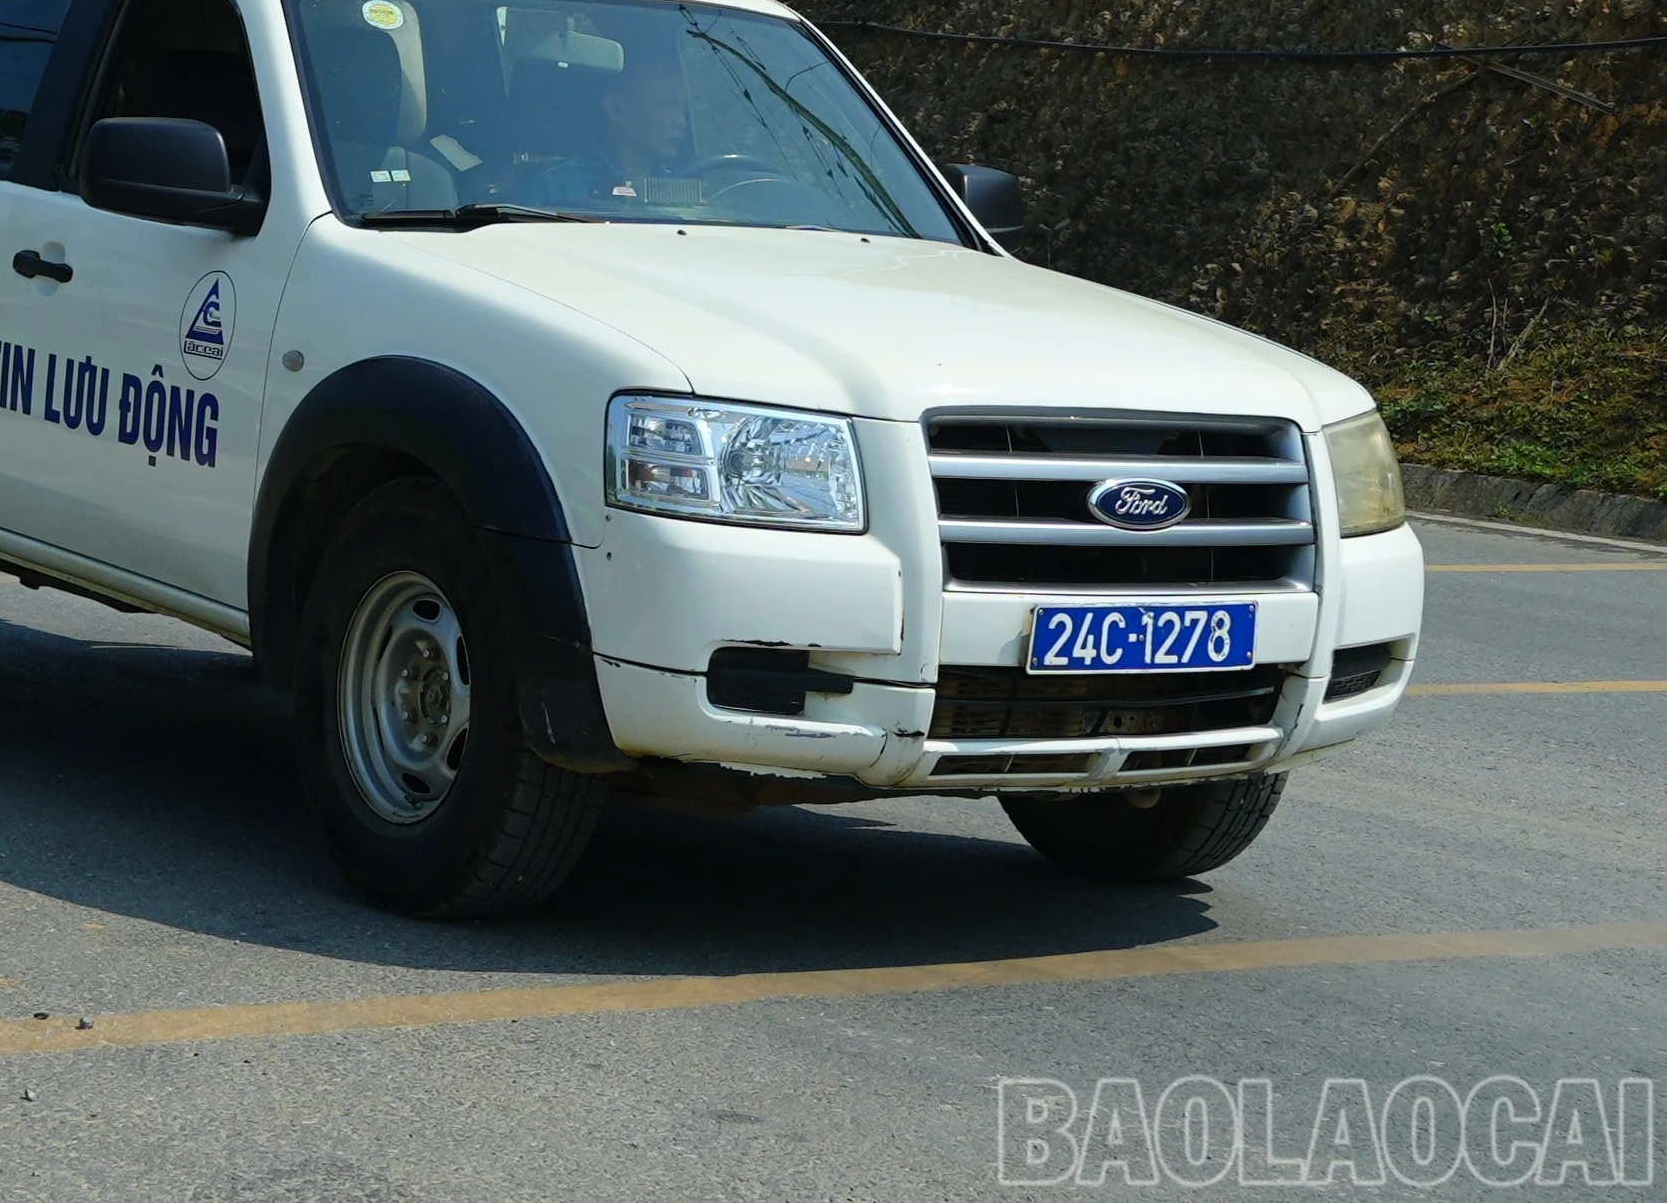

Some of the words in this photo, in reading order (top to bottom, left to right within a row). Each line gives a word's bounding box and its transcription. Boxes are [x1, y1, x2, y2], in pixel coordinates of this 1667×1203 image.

[44, 353, 110, 437] LƯU
[118, 365, 219, 469] ĐỘNG
[1115, 487, 1168, 516] Ford
[1043, 610, 1232, 666] 24C-1278
